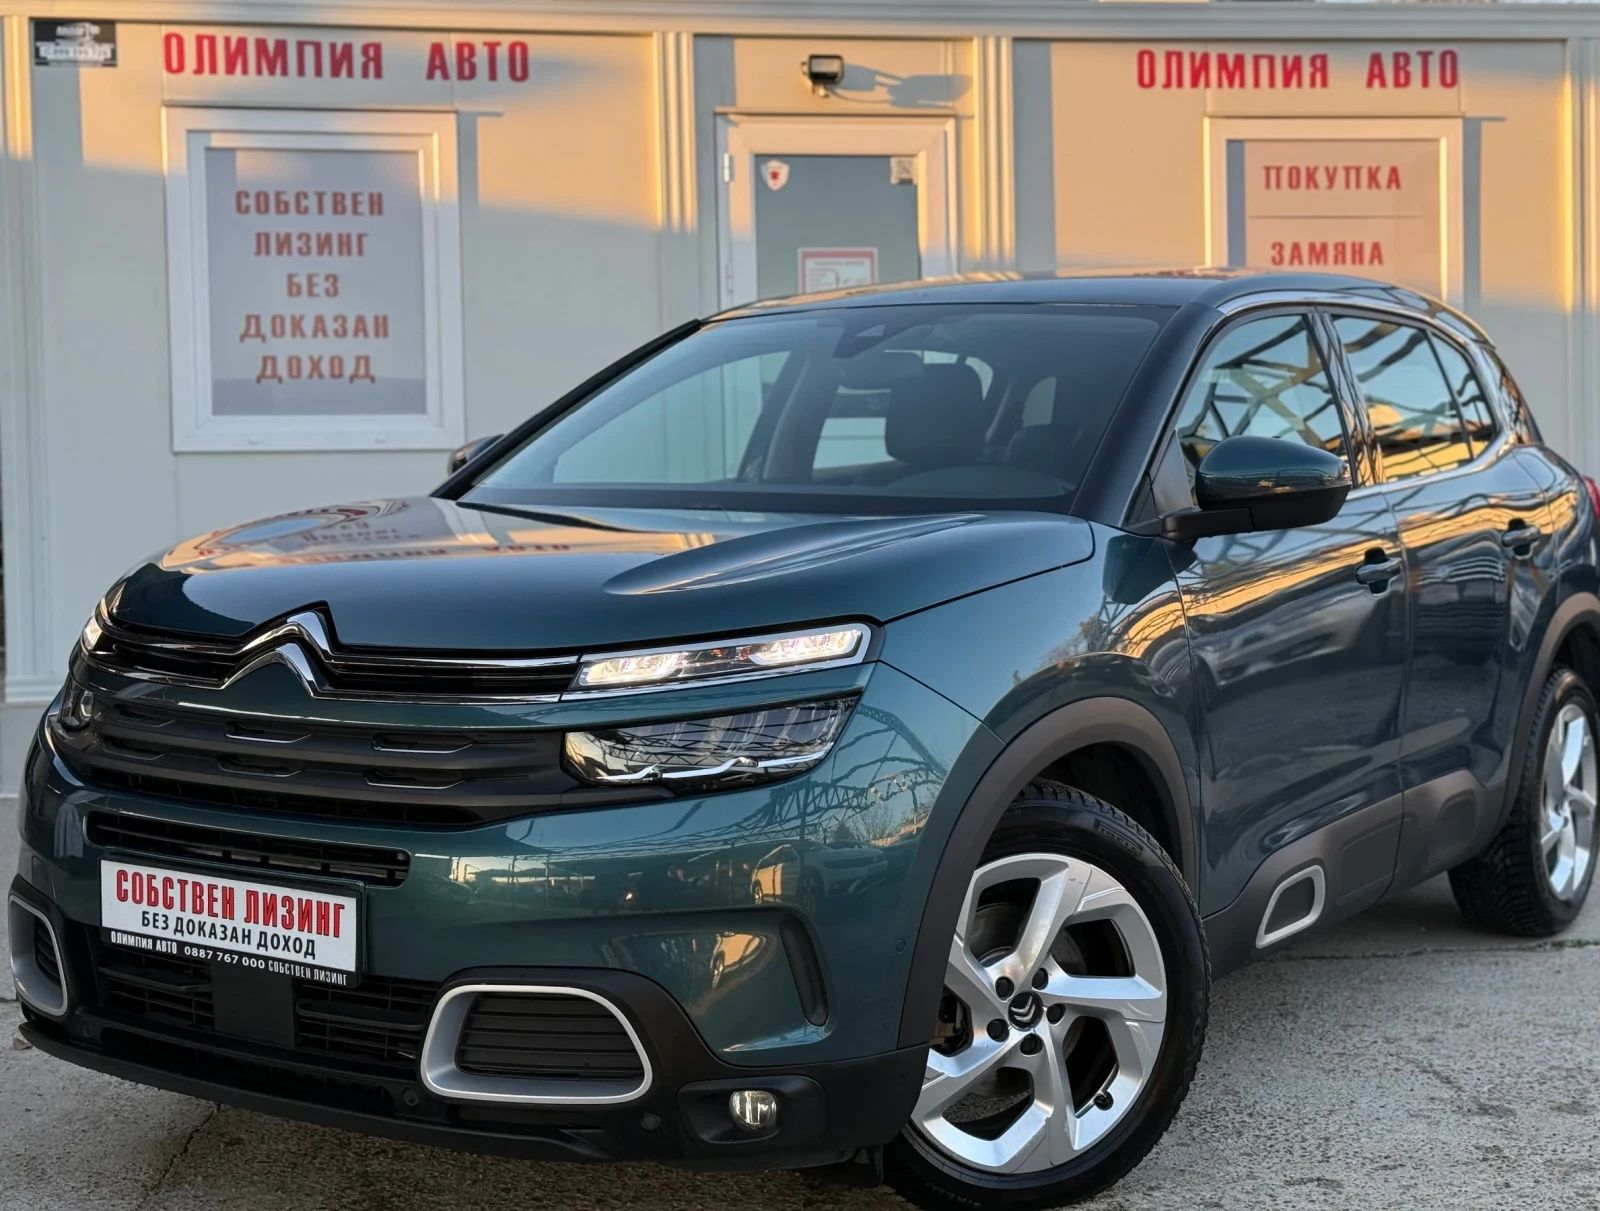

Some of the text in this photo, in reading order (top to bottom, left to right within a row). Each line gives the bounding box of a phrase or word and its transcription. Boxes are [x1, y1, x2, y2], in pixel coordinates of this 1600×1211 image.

[163, 32, 531, 83] ОЛИМПИЯ АВТО
[1136, 49, 1459, 89] ОЛИМПИЯ АВТО
[1263, 165, 1402, 190] ПОКУПКА
[235, 190, 384, 217] СОБСТВЕН
[253, 232, 369, 257] ЛИЗИНГ
[1270, 241, 1384, 266] ЗАМЯНА
[286, 273, 340, 299] БЕЗ
[239, 314, 390, 343] ДОКАЗАН
[255, 355, 376, 384] ДОХОД
[116, 869, 345, 938] СОБСТВЕН ЛИЗИНГ
[141, 910, 316, 961] БЕЗ ДОКАЗАН ДОХОД
[110, 930, 348, 986] ОЛИМПИЯ АВТО 0887 767 000 СОБСТВЕН ЛИЗИНГ
